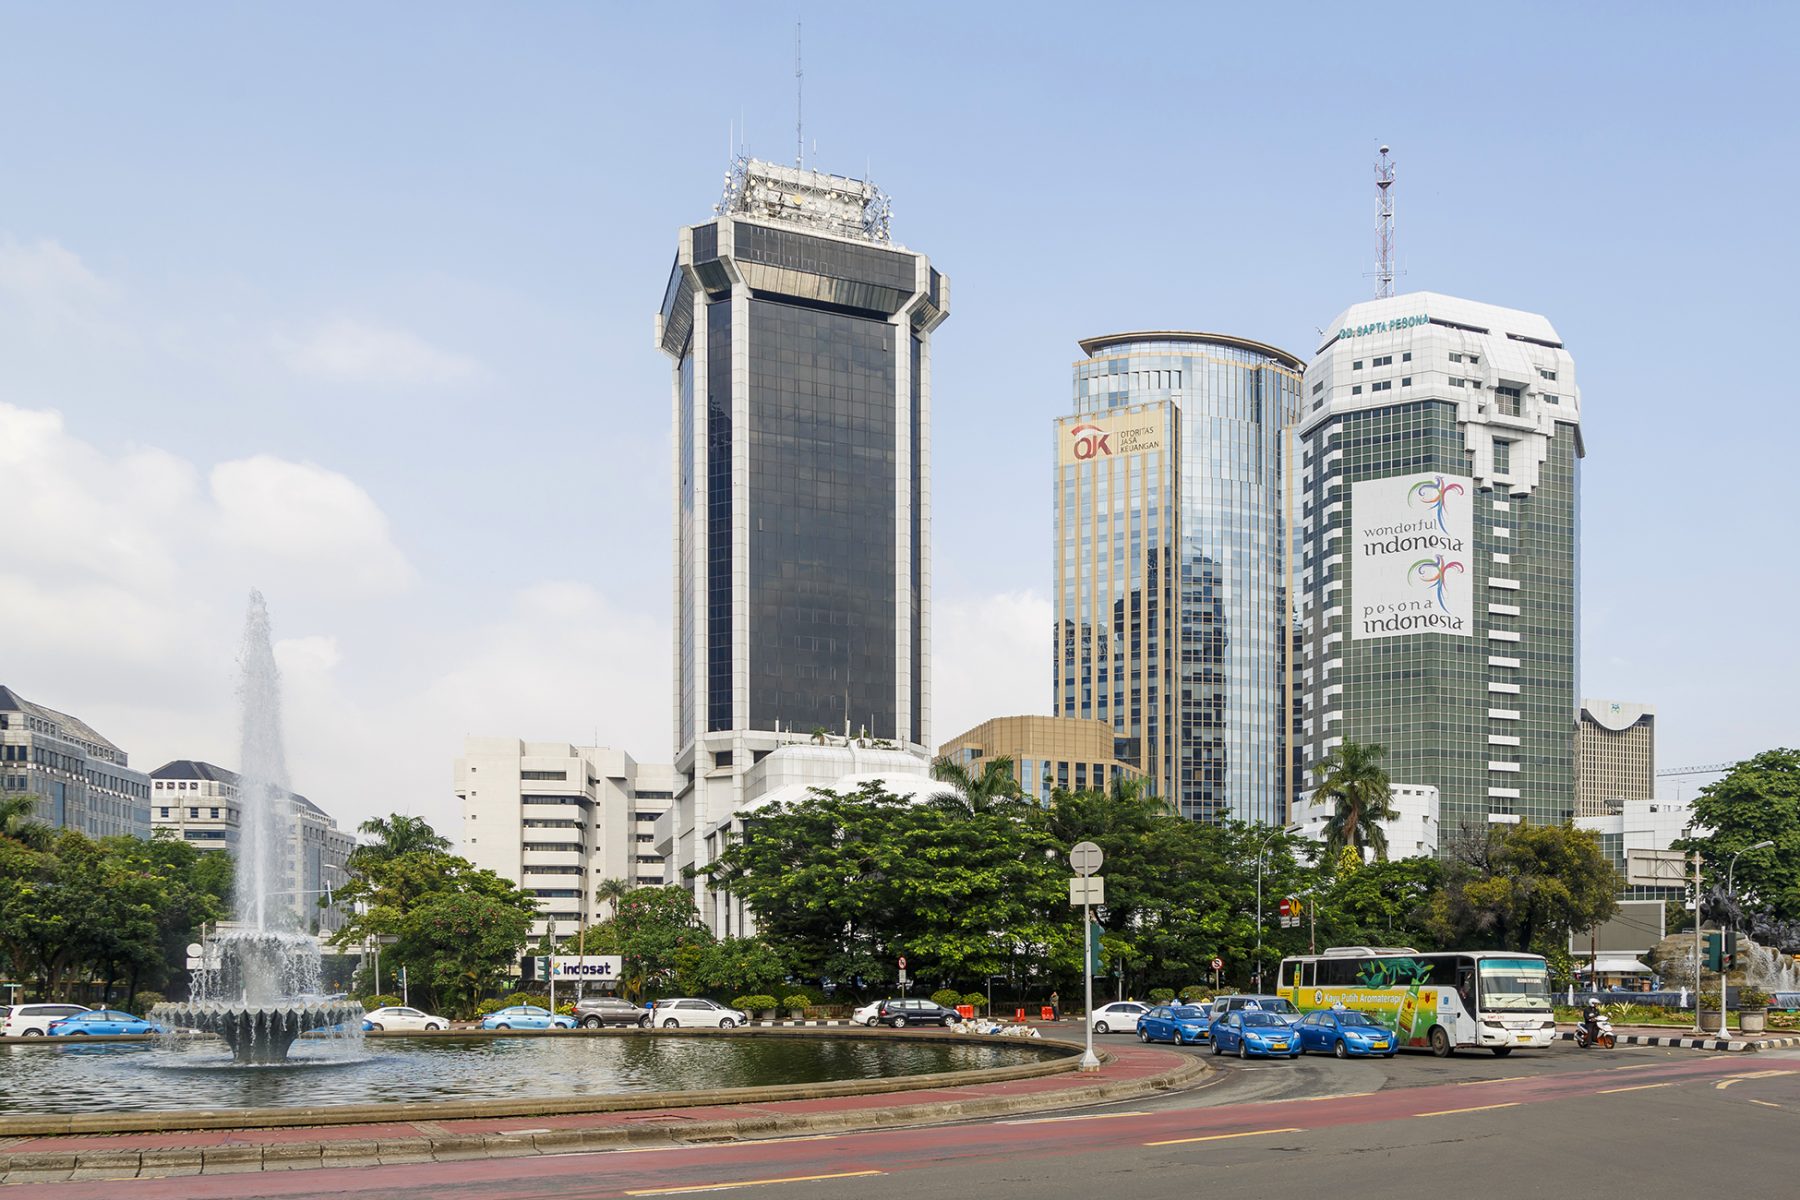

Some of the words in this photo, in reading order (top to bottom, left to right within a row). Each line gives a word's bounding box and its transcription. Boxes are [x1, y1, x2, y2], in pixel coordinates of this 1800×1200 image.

[1356, 322, 1387, 337] SAPTA
[1389, 313, 1430, 332] PESONA
[1120, 426, 1154, 438] OTORITAS
[1120, 436, 1138, 446] JASA
[1120, 441, 1159, 453] KEUANGAN
[1363, 518, 1438, 537] wonderful
[1363, 535, 1464, 556] indonesia
[1363, 599, 1433, 618] pesona
[1363, 613, 1464, 633] indonesia
[1341, 992, 1359, 1003] Putih
